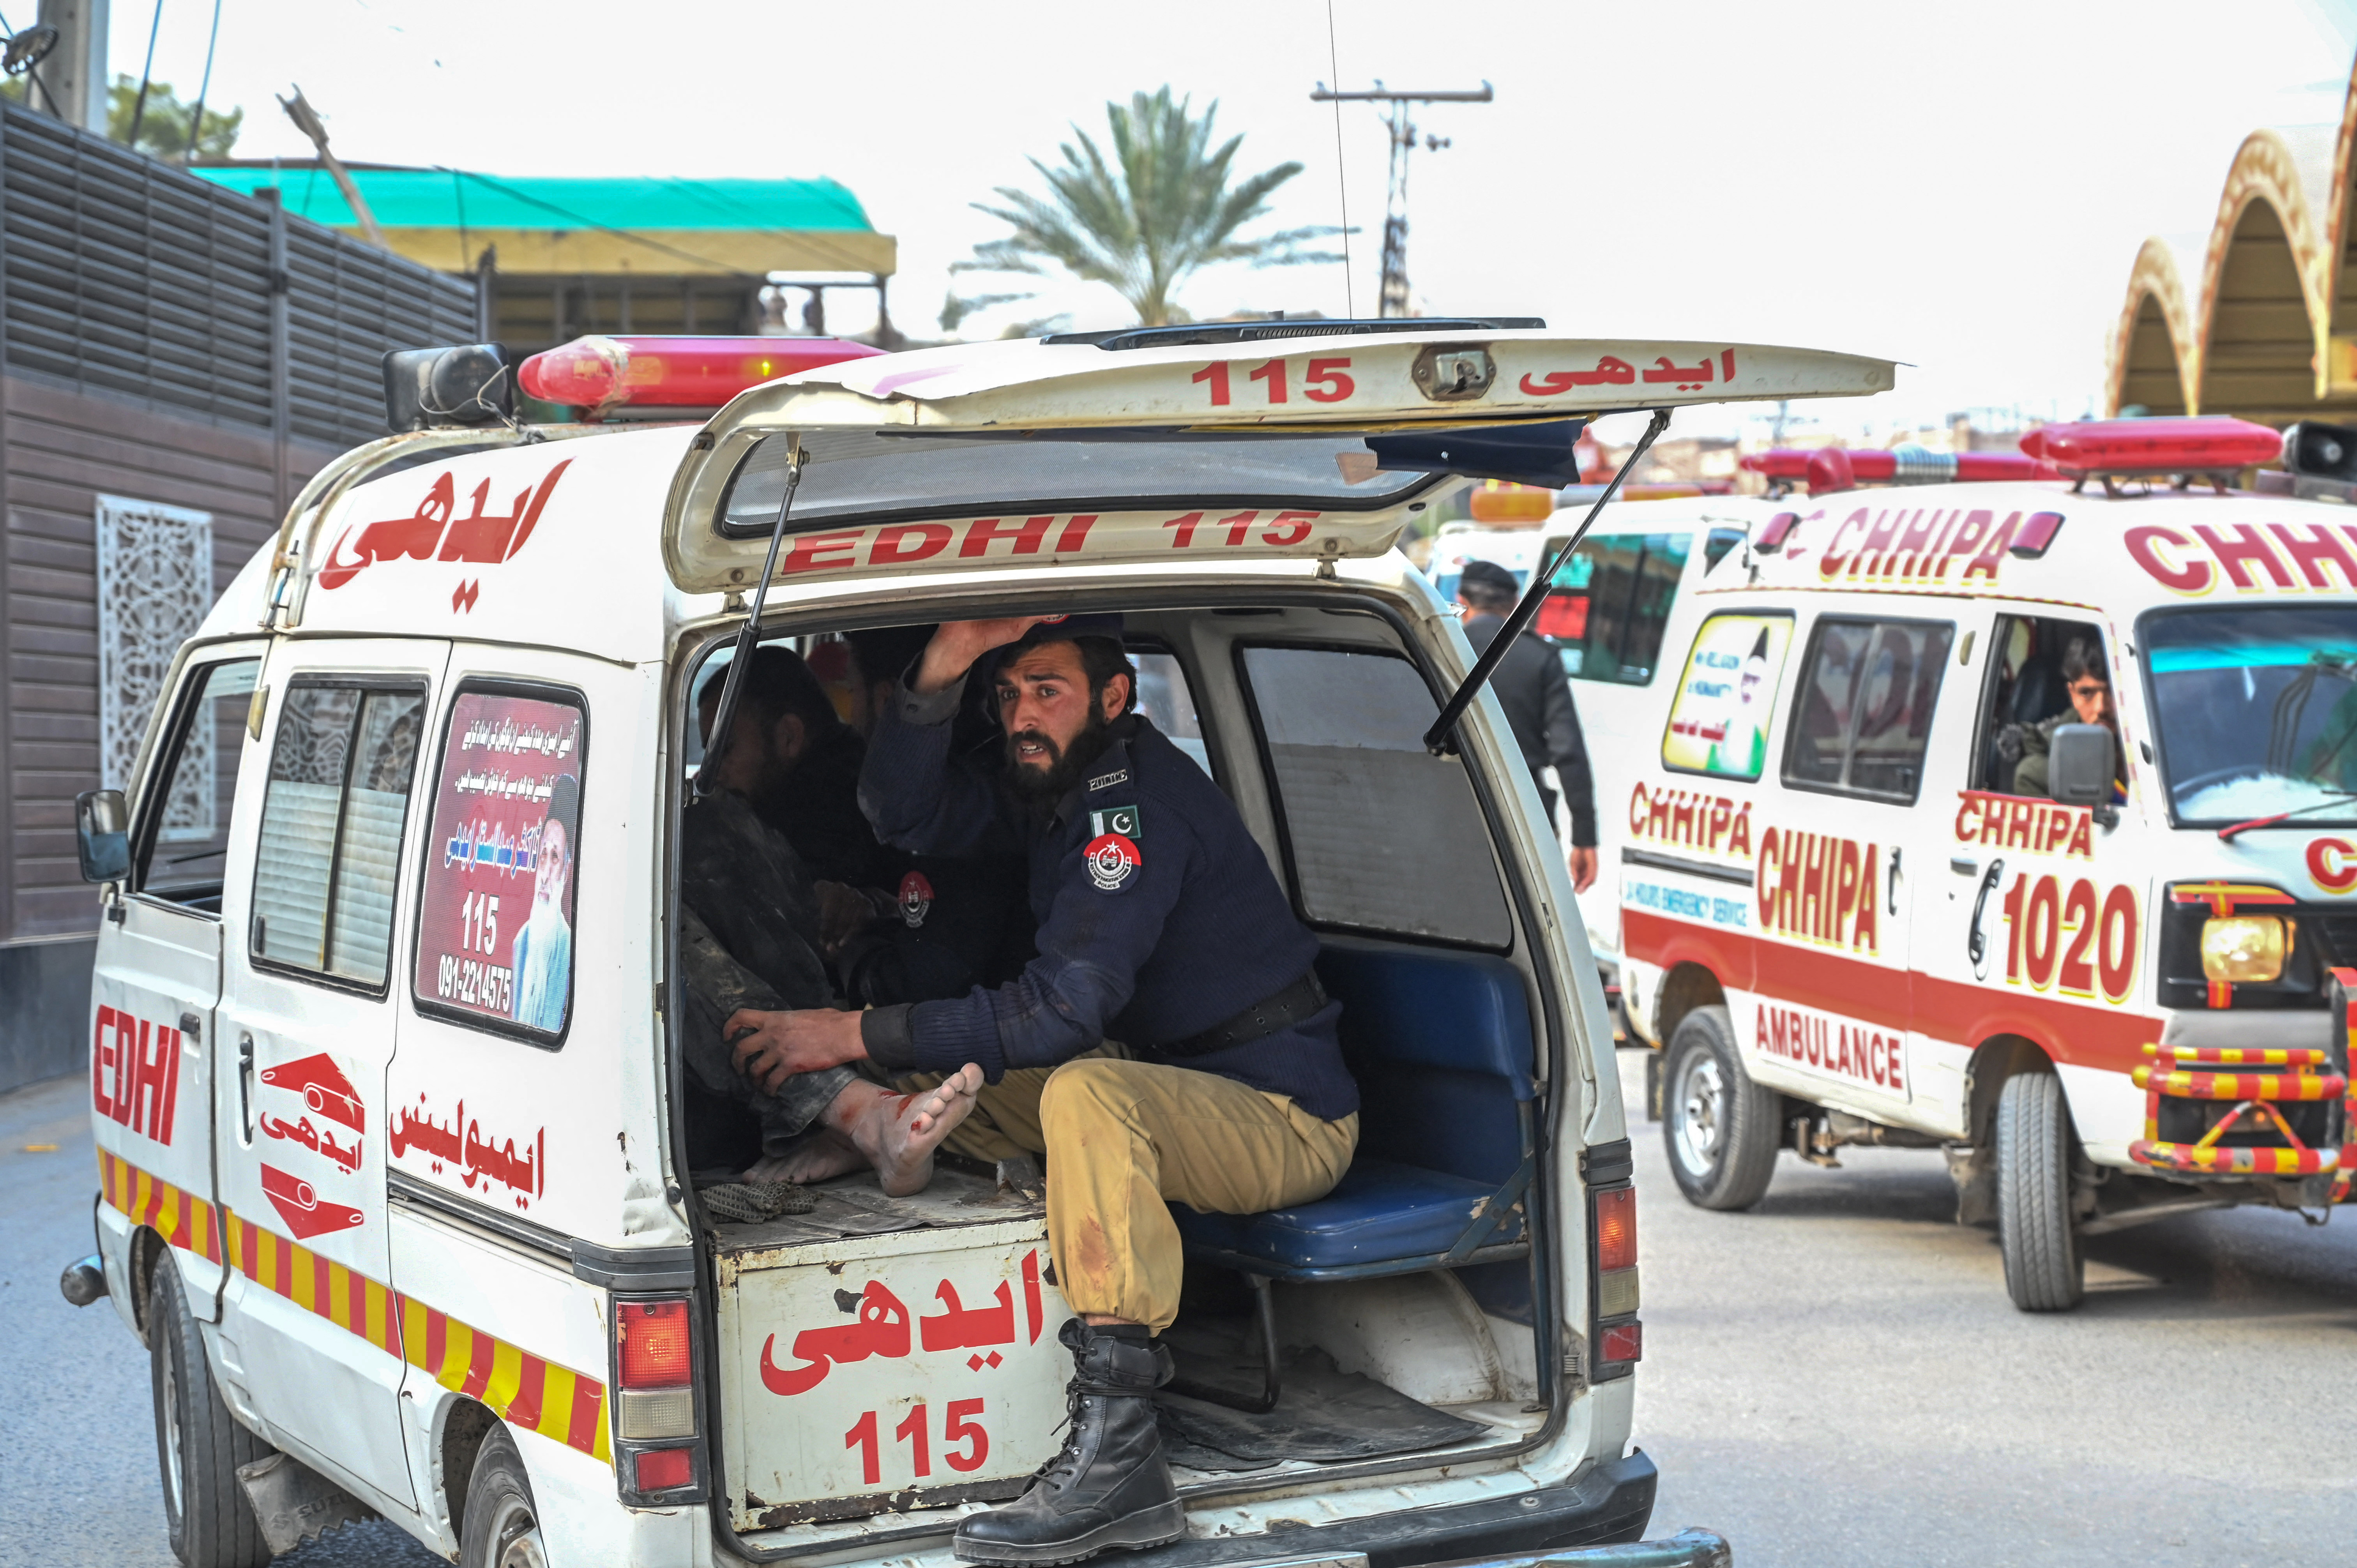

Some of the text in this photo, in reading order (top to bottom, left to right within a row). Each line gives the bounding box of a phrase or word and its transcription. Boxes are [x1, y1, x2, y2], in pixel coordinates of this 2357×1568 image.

[1192, 357, 1355, 406] 115
[1519, 348, 1735, 396] ایدھی
[782, 510, 1322, 576] EDHI 115
[1820, 507, 2024, 586] CHHIPA
[1088, 768, 1128, 792] POLICE
[1629, 781, 1753, 857] CHHIPA
[1955, 797, 2094, 860] CHHIPA
[461, 890, 499, 955] 115
[1758, 826, 1879, 956] CHHIPA
[2004, 872, 2141, 1004] 1020
[438, 954, 512, 1012] 091-2214575
[94, 1003, 180, 1146] EDHI
[1756, 1003, 1903, 1089] AMBULANCE
[260, 1111, 362, 1175] ایدھی
[390, 1091, 544, 1210] ایمبولینس
[760, 1248, 1043, 1396] ایدھی
[845, 1397, 989, 1485] 115
